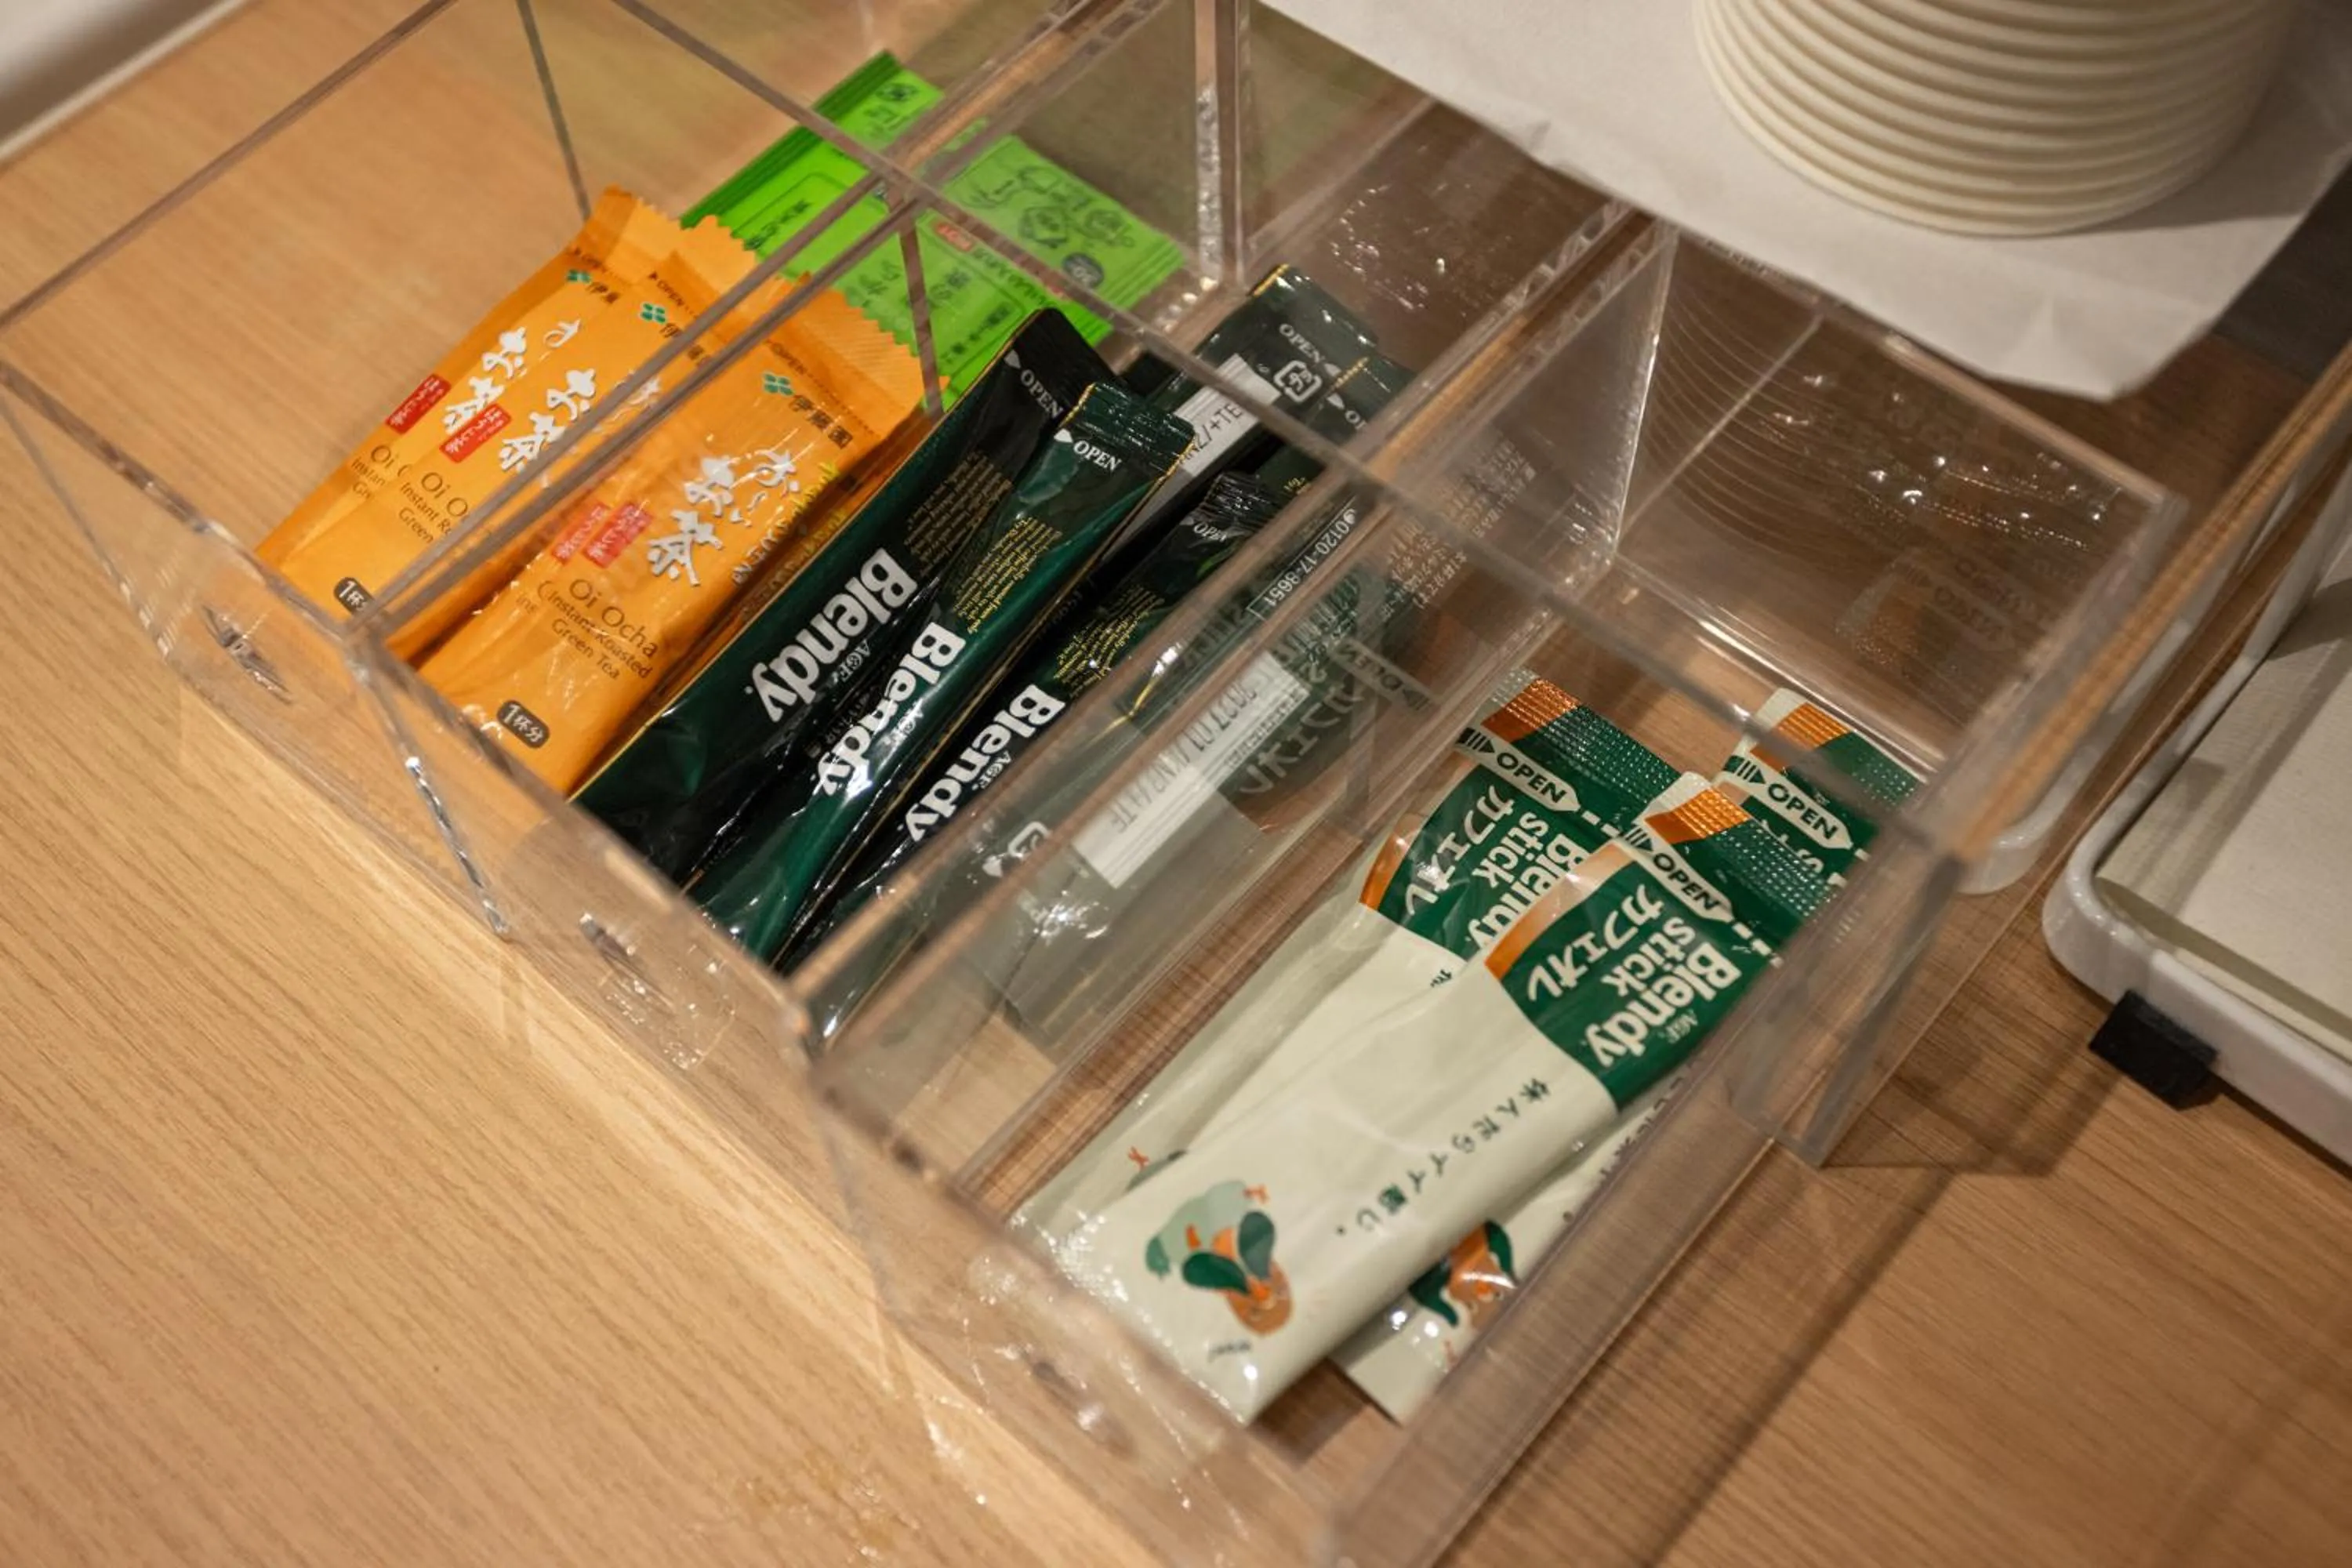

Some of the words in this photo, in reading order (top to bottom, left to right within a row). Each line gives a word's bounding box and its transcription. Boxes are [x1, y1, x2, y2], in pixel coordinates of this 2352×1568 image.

[1279, 323, 1326, 365] OPEN
[1019, 368, 1065, 419] OPEN
[370, 444, 401, 470] Oi
[420, 471, 452, 500] Oi
[1073, 439, 1122, 471] OPEN
[397, 506, 435, 544] Green
[399, 481, 441, 523] Instant
[551, 618, 594, 659] Green
[596, 654, 621, 681] Tea
[569, 579, 602, 608] Oi
[601, 605, 659, 660] Ocha
[752, 548, 919, 723] Blendy
[818, 622, 967, 797] Blendy
[905, 684, 1066, 842] Blendy
[1496, 750, 1567, 804] OPEN
[1767, 783, 1839, 840] OPEN
[1405, 784, 1515, 916] カフェオレ
[1472, 811, 1550, 889] stick
[1653, 851, 1721, 913] OPEN
[1526, 884, 1665, 1002] カフェオレ
[1601, 916, 1696, 996] stick
[1584, 942, 1743, 1068] Blendy
